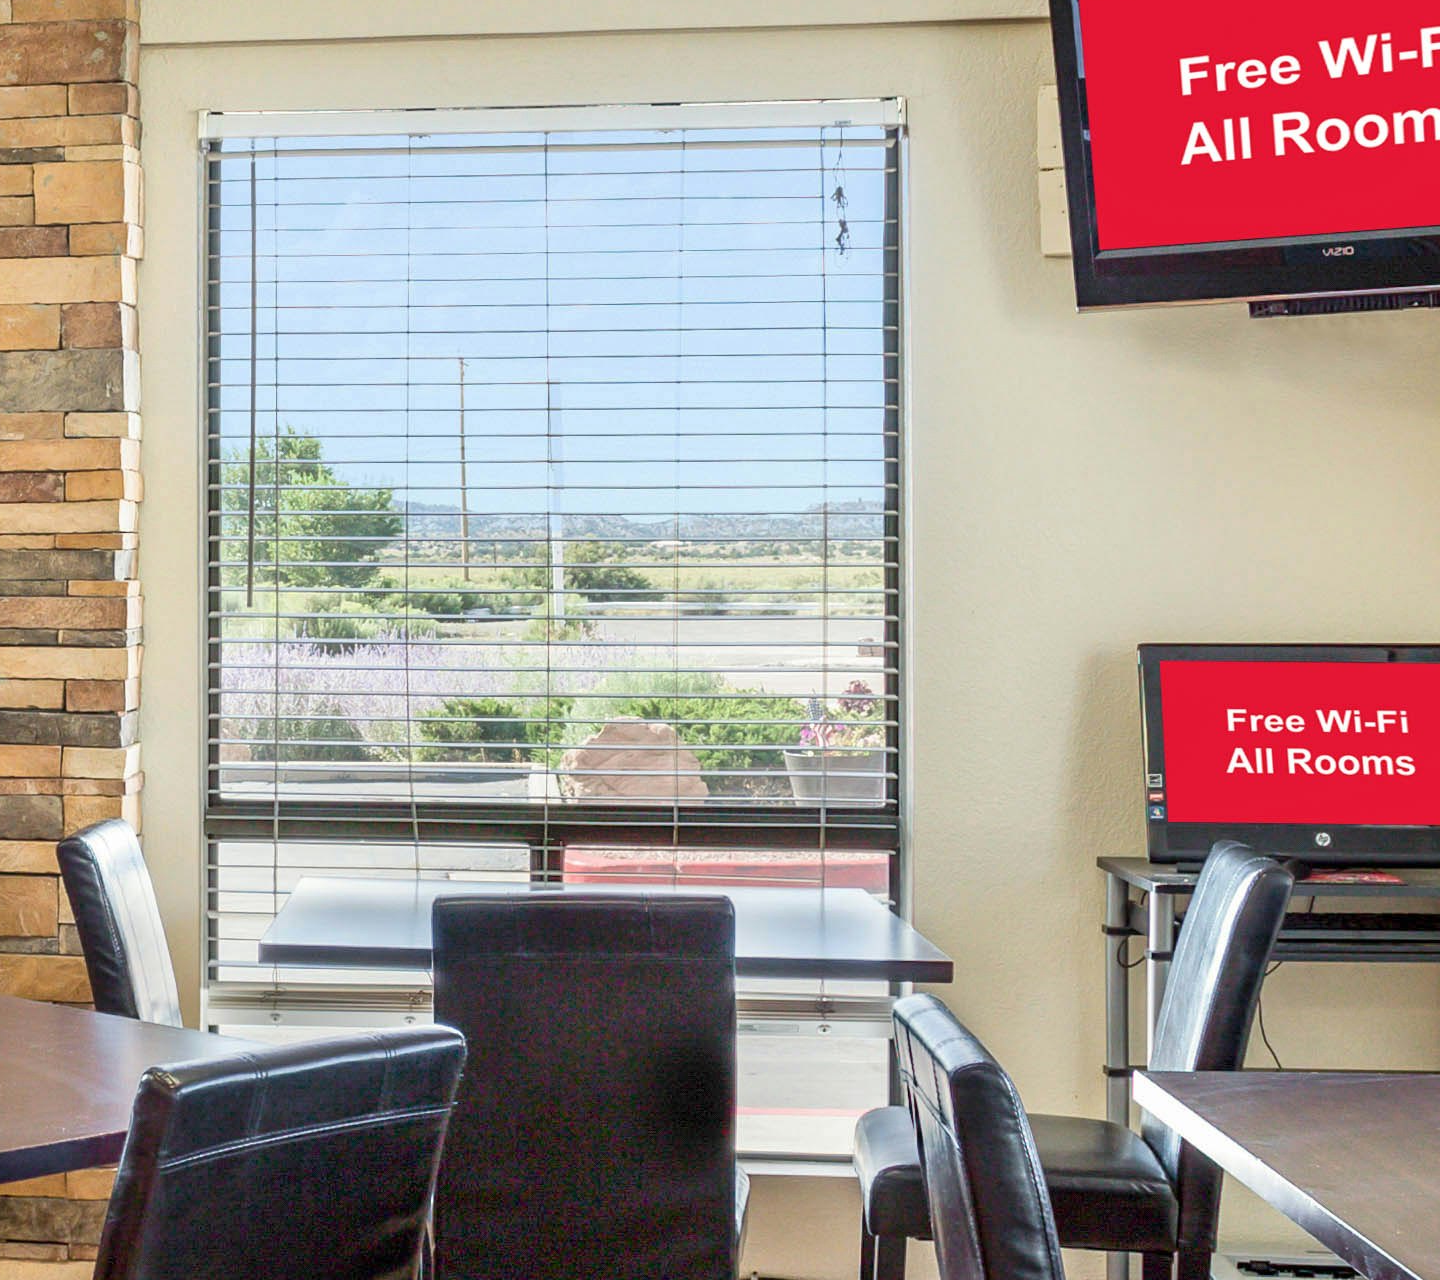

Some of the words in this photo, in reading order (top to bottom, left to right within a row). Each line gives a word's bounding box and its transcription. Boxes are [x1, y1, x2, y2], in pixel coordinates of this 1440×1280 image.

[1180, 55, 1301, 96] Free
[1181, 117, 1252, 166] All
[1227, 709, 1306, 733] Free
[1316, 709, 1409, 734] Wi-Fi
[1227, 747, 1275, 774] All
[1287, 748, 1416, 776] Rooms
